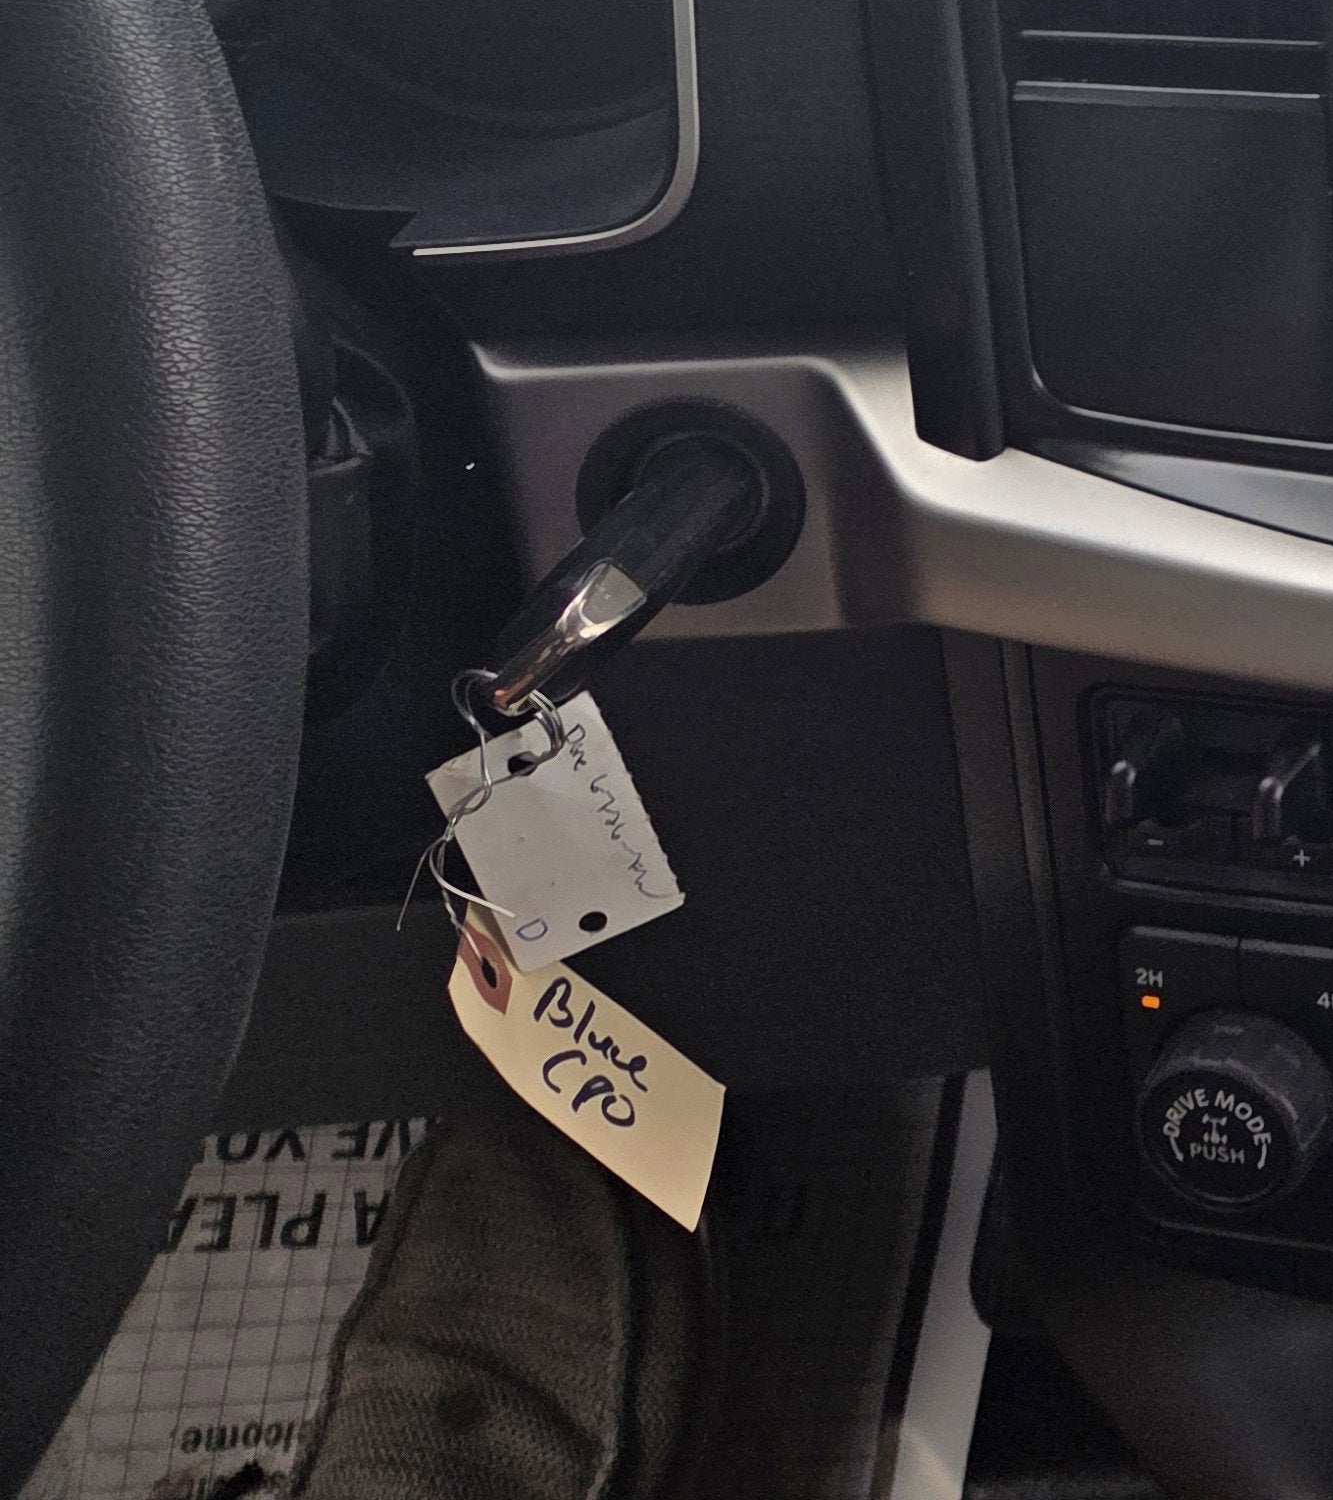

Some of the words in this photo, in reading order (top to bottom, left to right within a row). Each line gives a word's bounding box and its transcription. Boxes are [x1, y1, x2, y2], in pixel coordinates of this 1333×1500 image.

[1135, 966, 1164, 989] 2H
[533, 976, 649, 1094] Blue
[541, 1048, 636, 1128] CPO
[1162, 1088, 1209, 1141] DRIVE
[1214, 1088, 1272, 1147] MODE
[1189, 1141, 1246, 1165] PUSH
[353, 1190, 391, 1248] A
[179, 1421, 304, 1455] lcome
